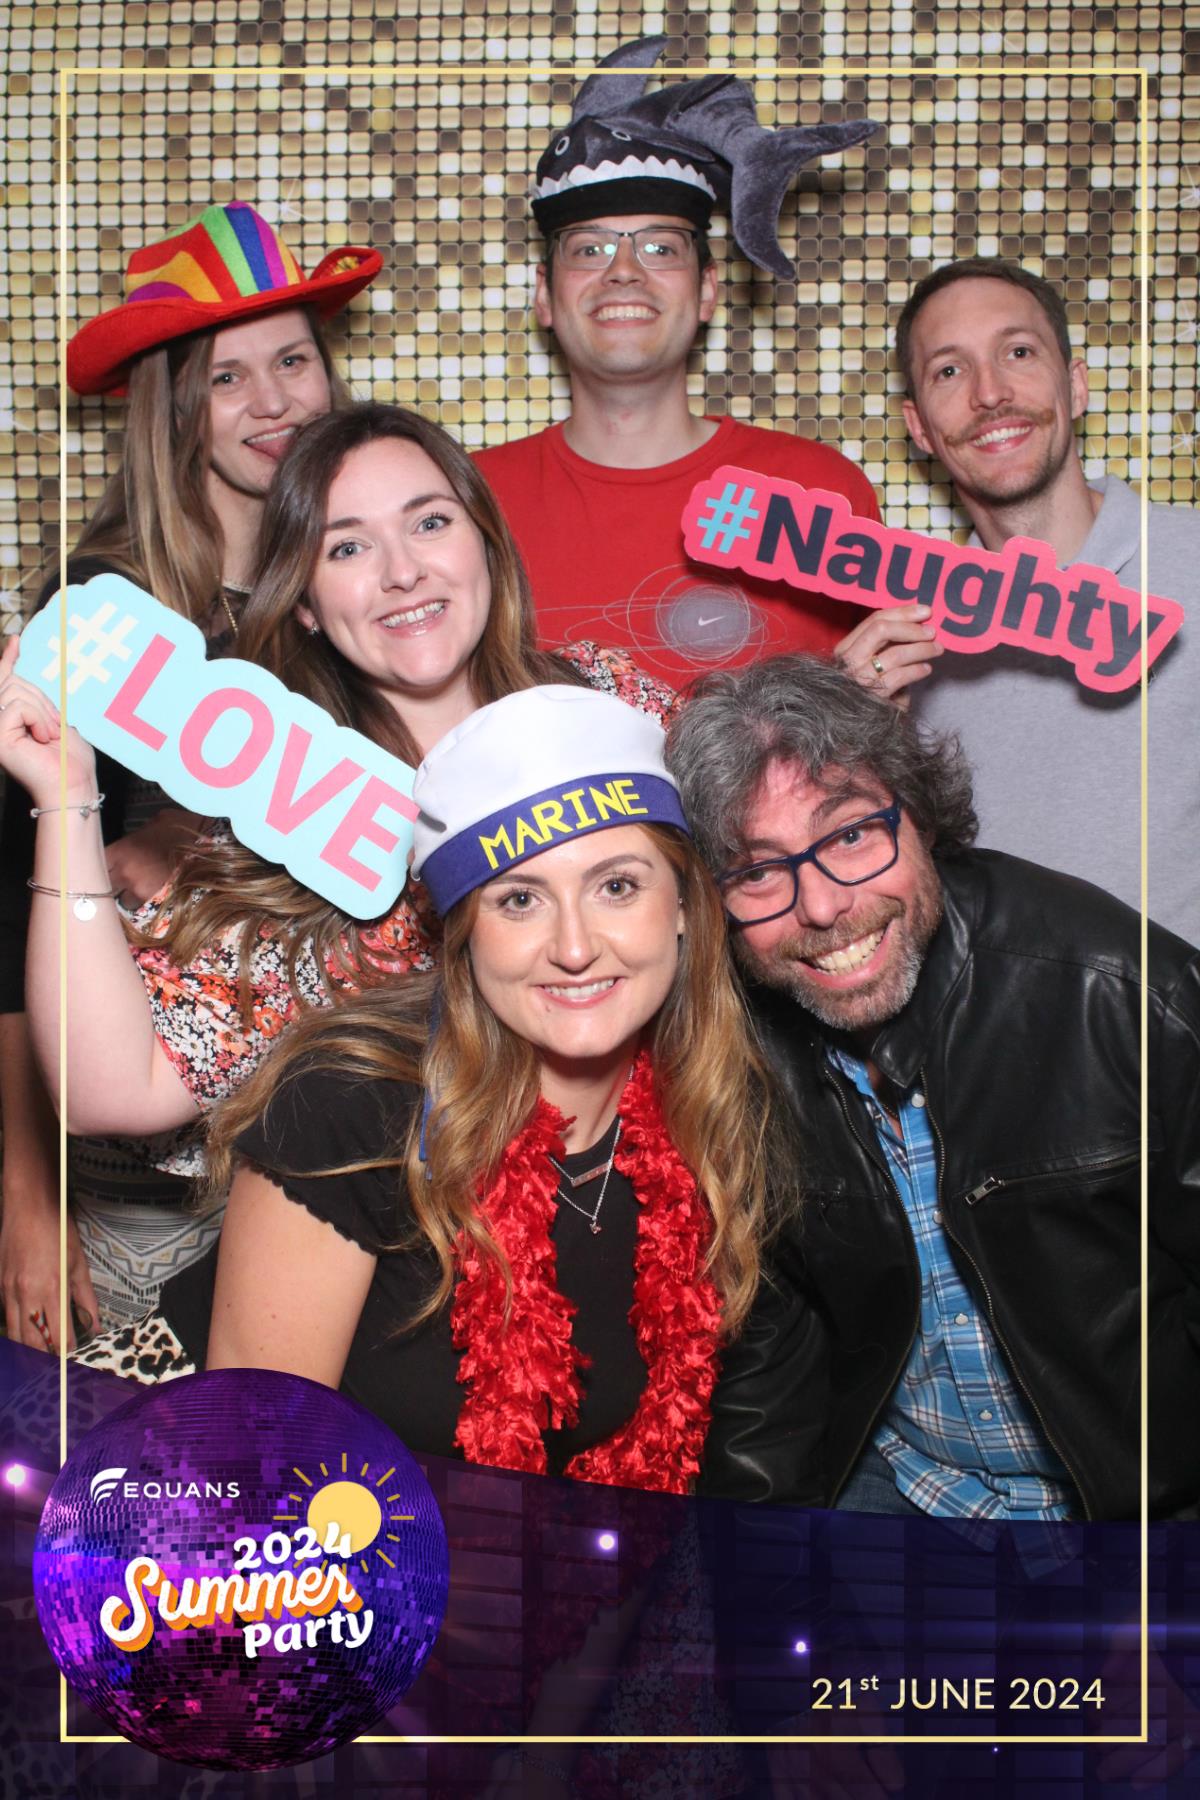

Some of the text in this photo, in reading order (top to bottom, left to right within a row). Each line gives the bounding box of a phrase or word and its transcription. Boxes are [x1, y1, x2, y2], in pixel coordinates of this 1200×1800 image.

[697, 482, 1164, 676] #Naughty
[41, 601, 420, 893] #LOVE
[479, 779, 648, 870] MARINE
